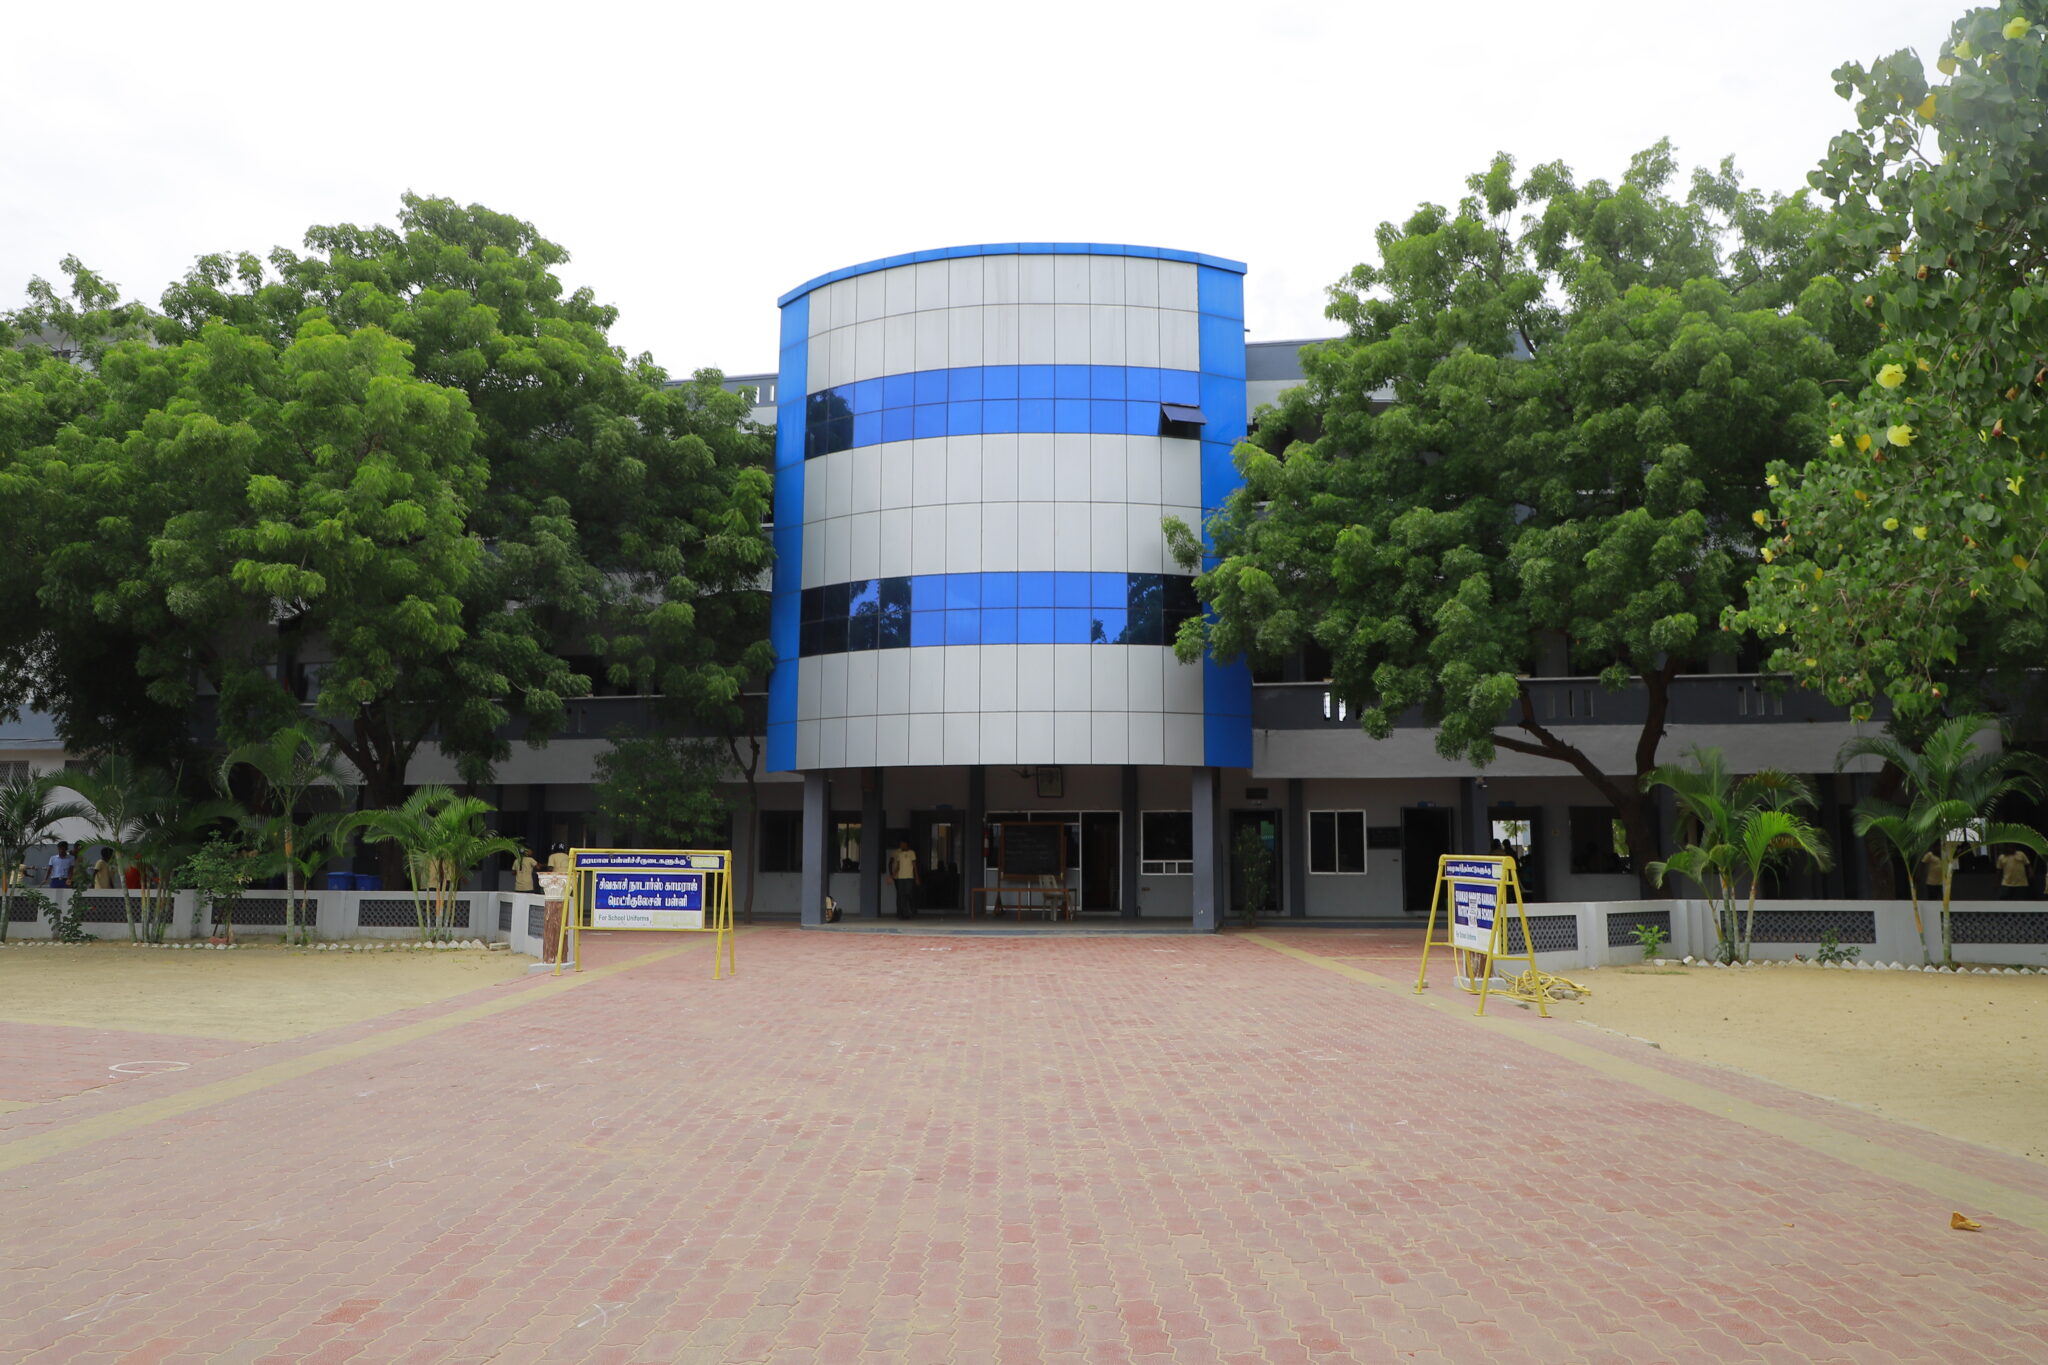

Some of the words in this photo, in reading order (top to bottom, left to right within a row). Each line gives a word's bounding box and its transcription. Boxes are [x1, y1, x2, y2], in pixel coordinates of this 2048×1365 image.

[599, 877, 628, 891] சிவகாசி
[628, 877, 663, 893] நாடார்ஸ்
[664, 878, 698, 893] காமராஜ்
[665, 893, 688, 907] பள்ளி
[607, 913, 626, 922] School
[626, 913, 650, 922] Uniforms
